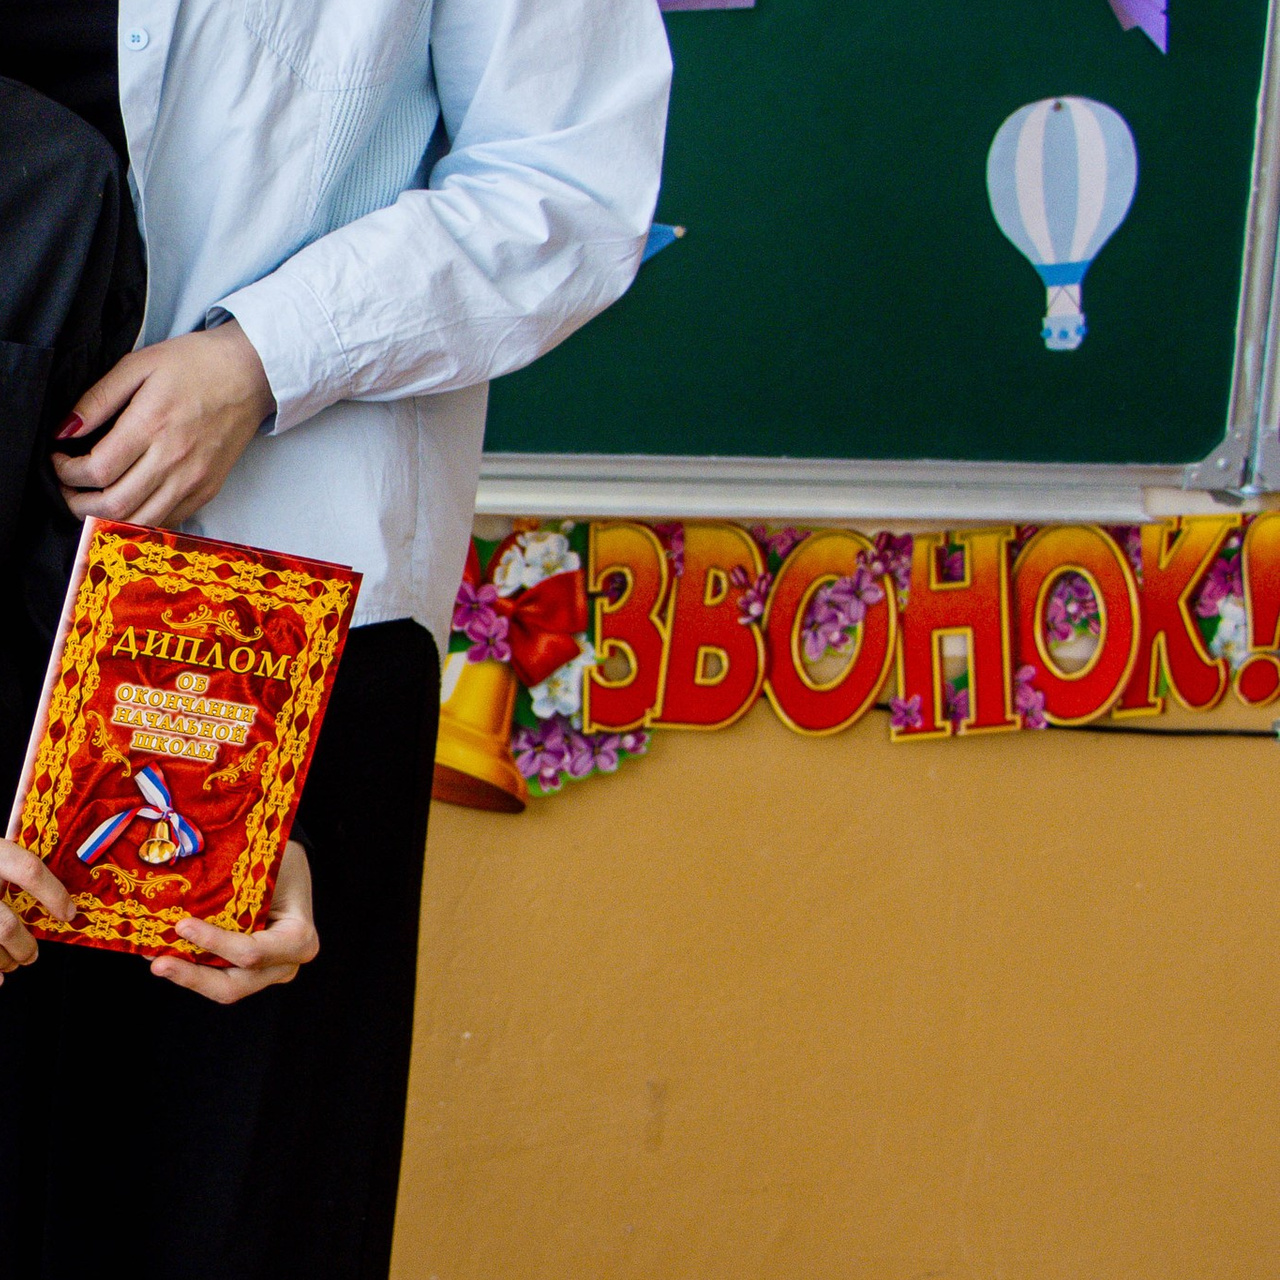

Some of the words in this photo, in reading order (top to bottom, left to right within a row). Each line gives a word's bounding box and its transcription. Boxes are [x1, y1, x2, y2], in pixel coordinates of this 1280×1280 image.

[112, 625, 292, 681] ДИПЛОМ
[178, 673, 209, 693] ОБ
[117, 685, 256, 723] ОКОНЧАНИИ
[113, 706, 248, 744] НАЧАЛЬНОЙ
[131, 732, 218, 760] ШКОЛЫ
